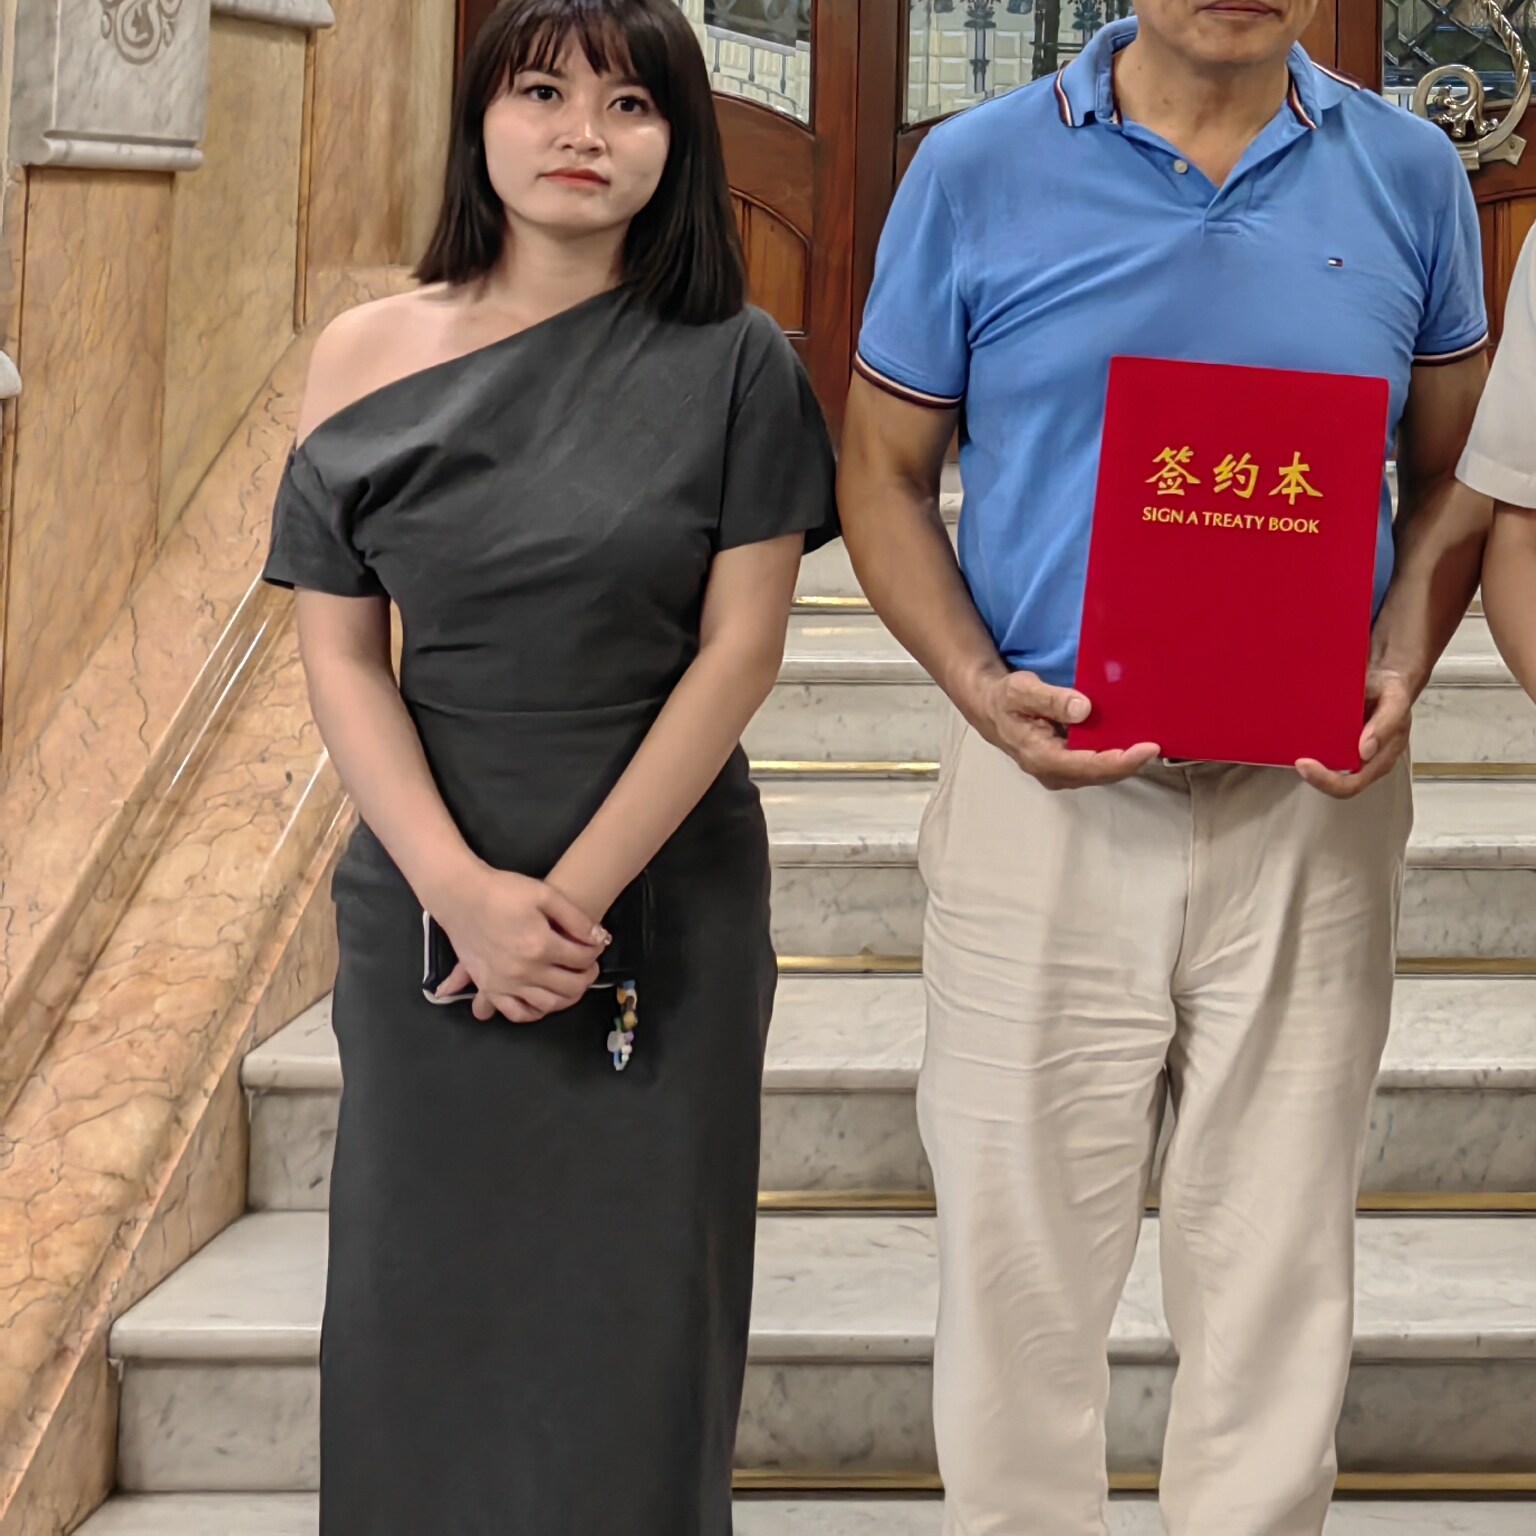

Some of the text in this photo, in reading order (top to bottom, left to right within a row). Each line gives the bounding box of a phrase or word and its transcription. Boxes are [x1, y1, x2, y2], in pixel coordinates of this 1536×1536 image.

[1144, 445, 1324, 505] 签约本
[1141, 506, 1321, 534] SIGN A TREATY BOOK
